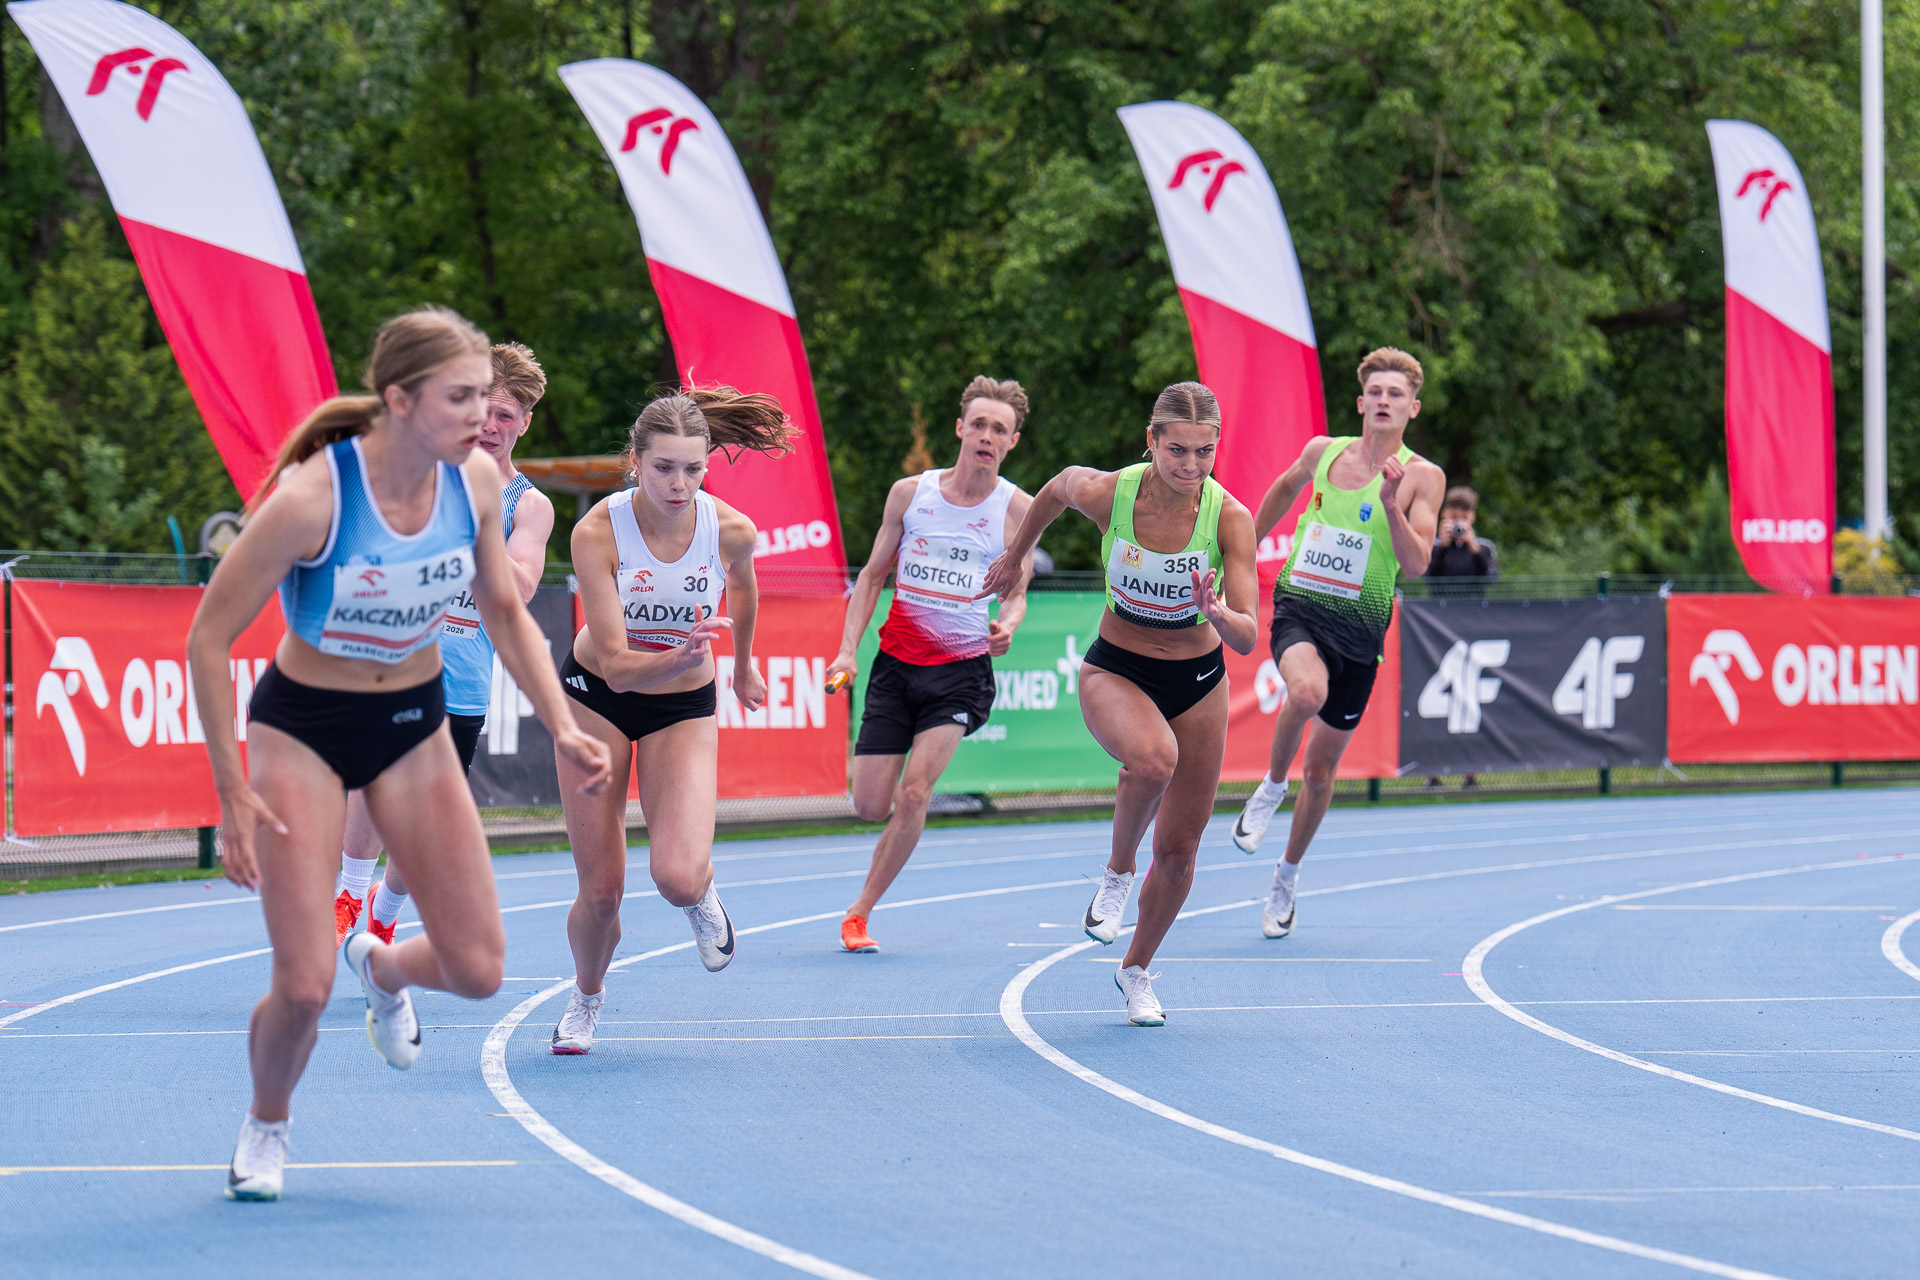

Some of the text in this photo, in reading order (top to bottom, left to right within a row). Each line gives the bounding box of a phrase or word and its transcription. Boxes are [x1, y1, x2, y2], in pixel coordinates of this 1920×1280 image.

[1336, 533, 1363, 550] 366
[949, 547, 969, 562] 33
[1164, 556, 1199, 574] 358
[1304, 549, 1352, 574] SUDOŁ
[418, 557, 462, 587] 143
[683, 576, 708, 593] 30
[903, 560, 973, 589] KOSTECKI
[630, 585, 654, 593] ORLEN
[1120, 575, 1192, 600] JANIEC
[1120, 599, 1168, 618] PIASECZNO
[1168, 609, 1190, 619] 2026
[445, 625, 465, 635] 2026
[1418, 640, 1511, 734] 4F
[1552, 635, 1645, 729] 4F
[1772, 643, 1919, 707] ORLEN
[716, 655, 826, 729] RLEN
[991, 669, 1059, 710] XMED
[120, 658, 268, 748] ORLN
